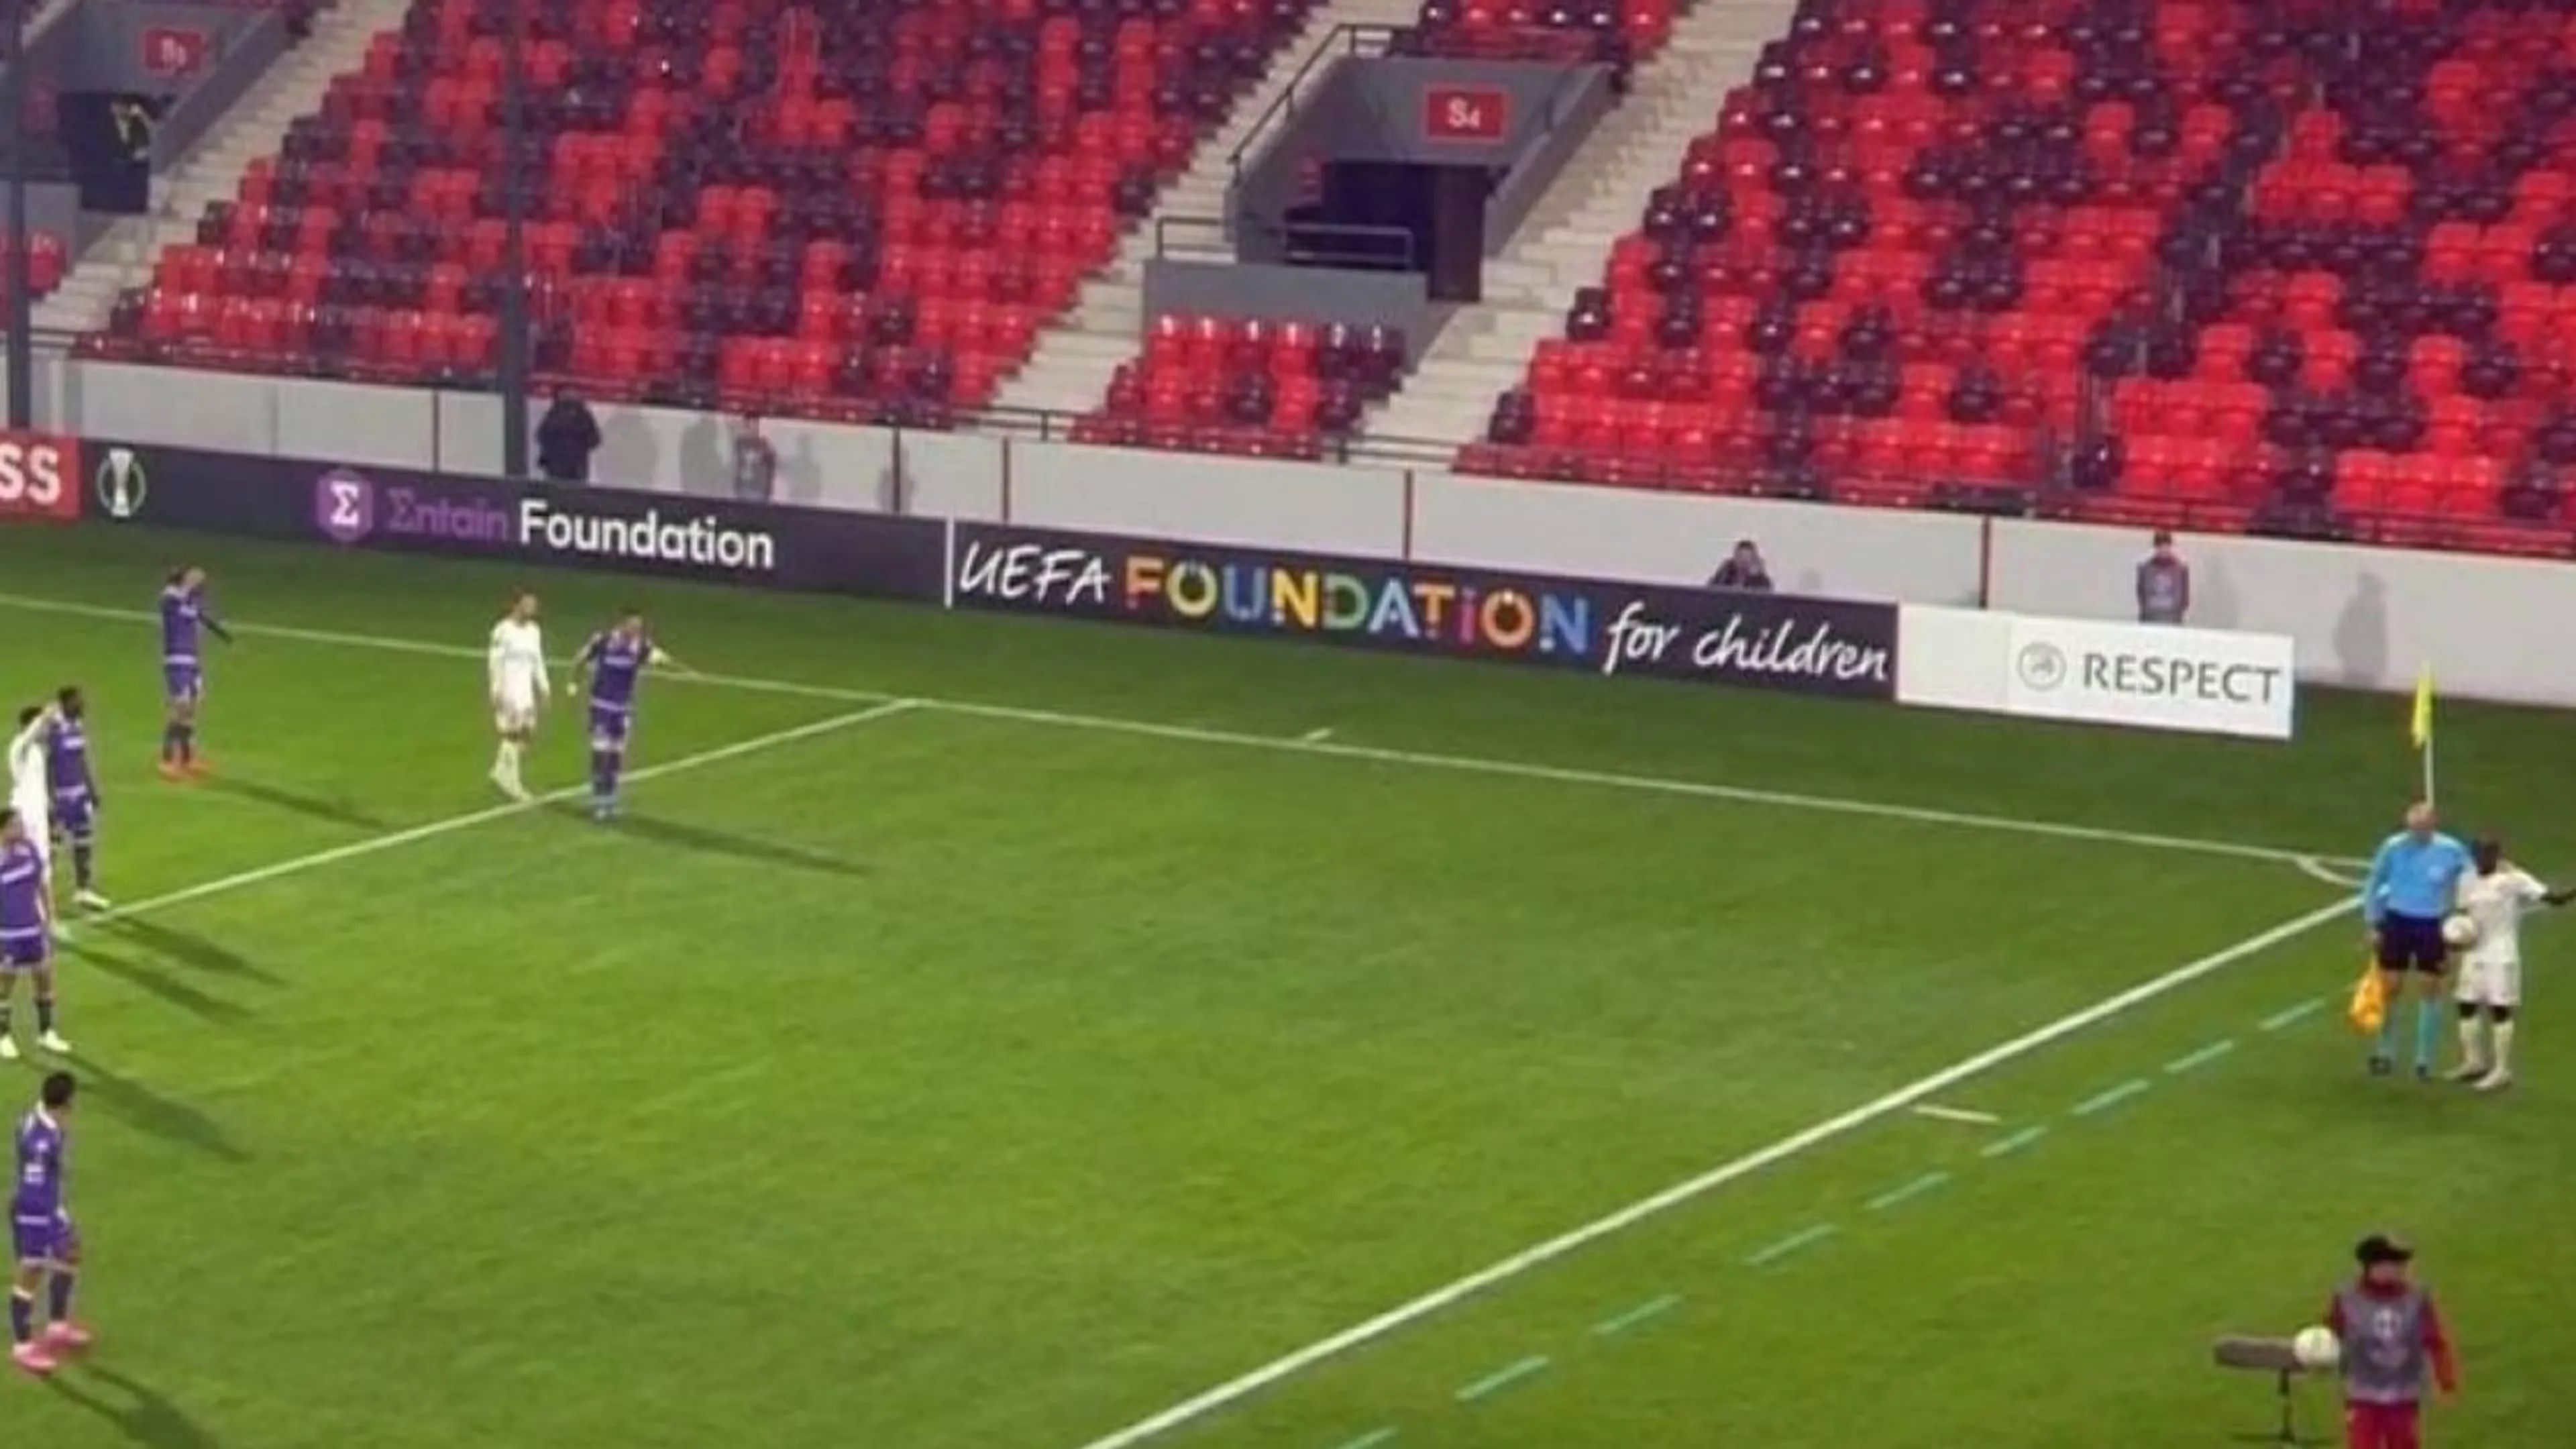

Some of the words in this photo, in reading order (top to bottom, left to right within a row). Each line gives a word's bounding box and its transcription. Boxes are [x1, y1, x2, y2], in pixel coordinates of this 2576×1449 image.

[521, 499, 773, 569] Foundation
[960, 541, 1110, 605] UEFA
[1603, 602, 1678, 676] for
[1693, 614, 1888, 681] children
[2082, 653, 2281, 703] RESPECT
